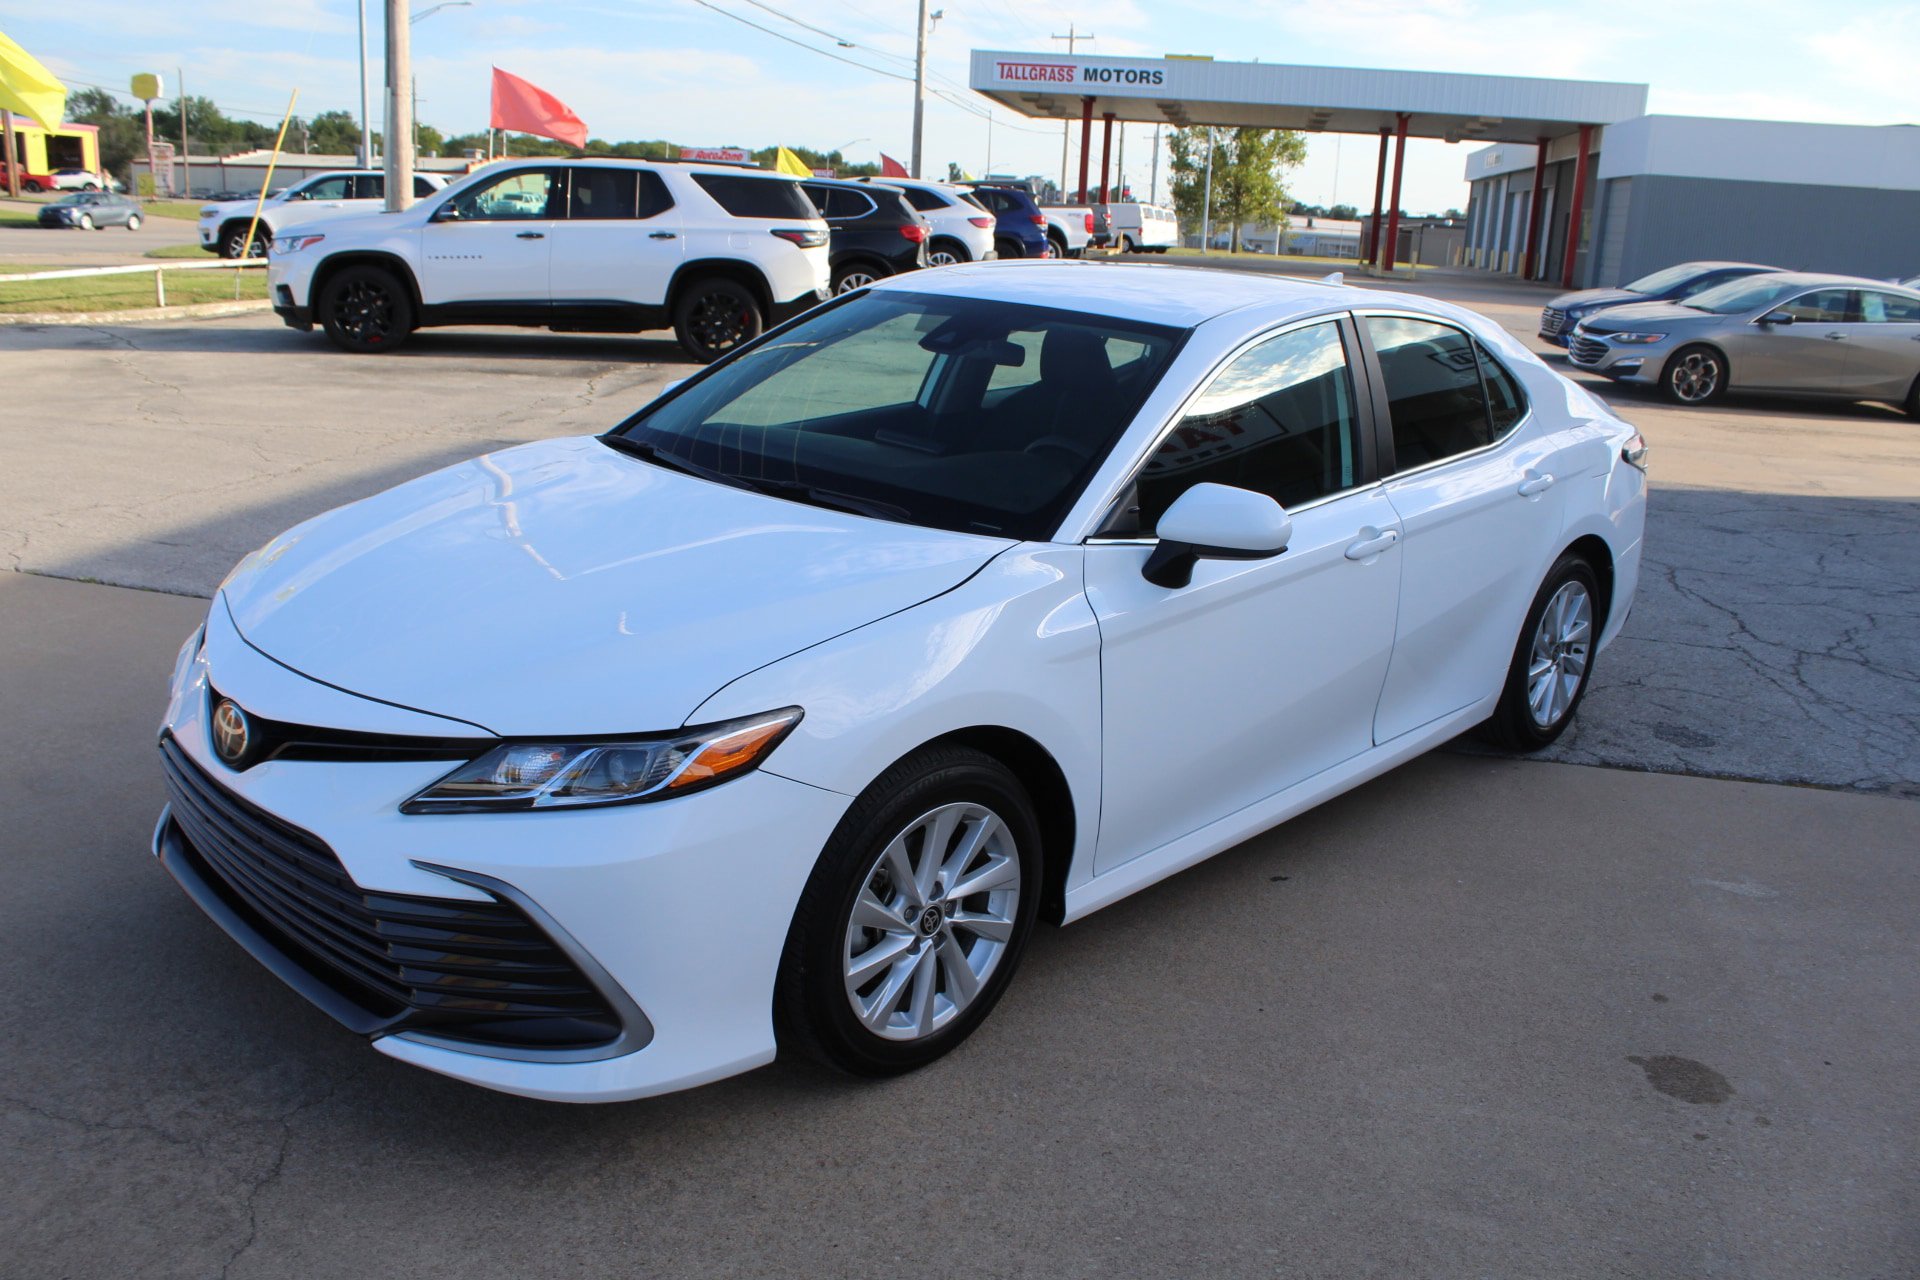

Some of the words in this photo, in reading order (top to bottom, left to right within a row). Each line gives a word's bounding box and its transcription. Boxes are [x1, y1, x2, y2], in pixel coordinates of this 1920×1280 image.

[997, 62, 1077, 83] TALLGRASS
[1083, 67, 1163, 85] MOTORS
[696, 150, 743, 161] AutoZone
